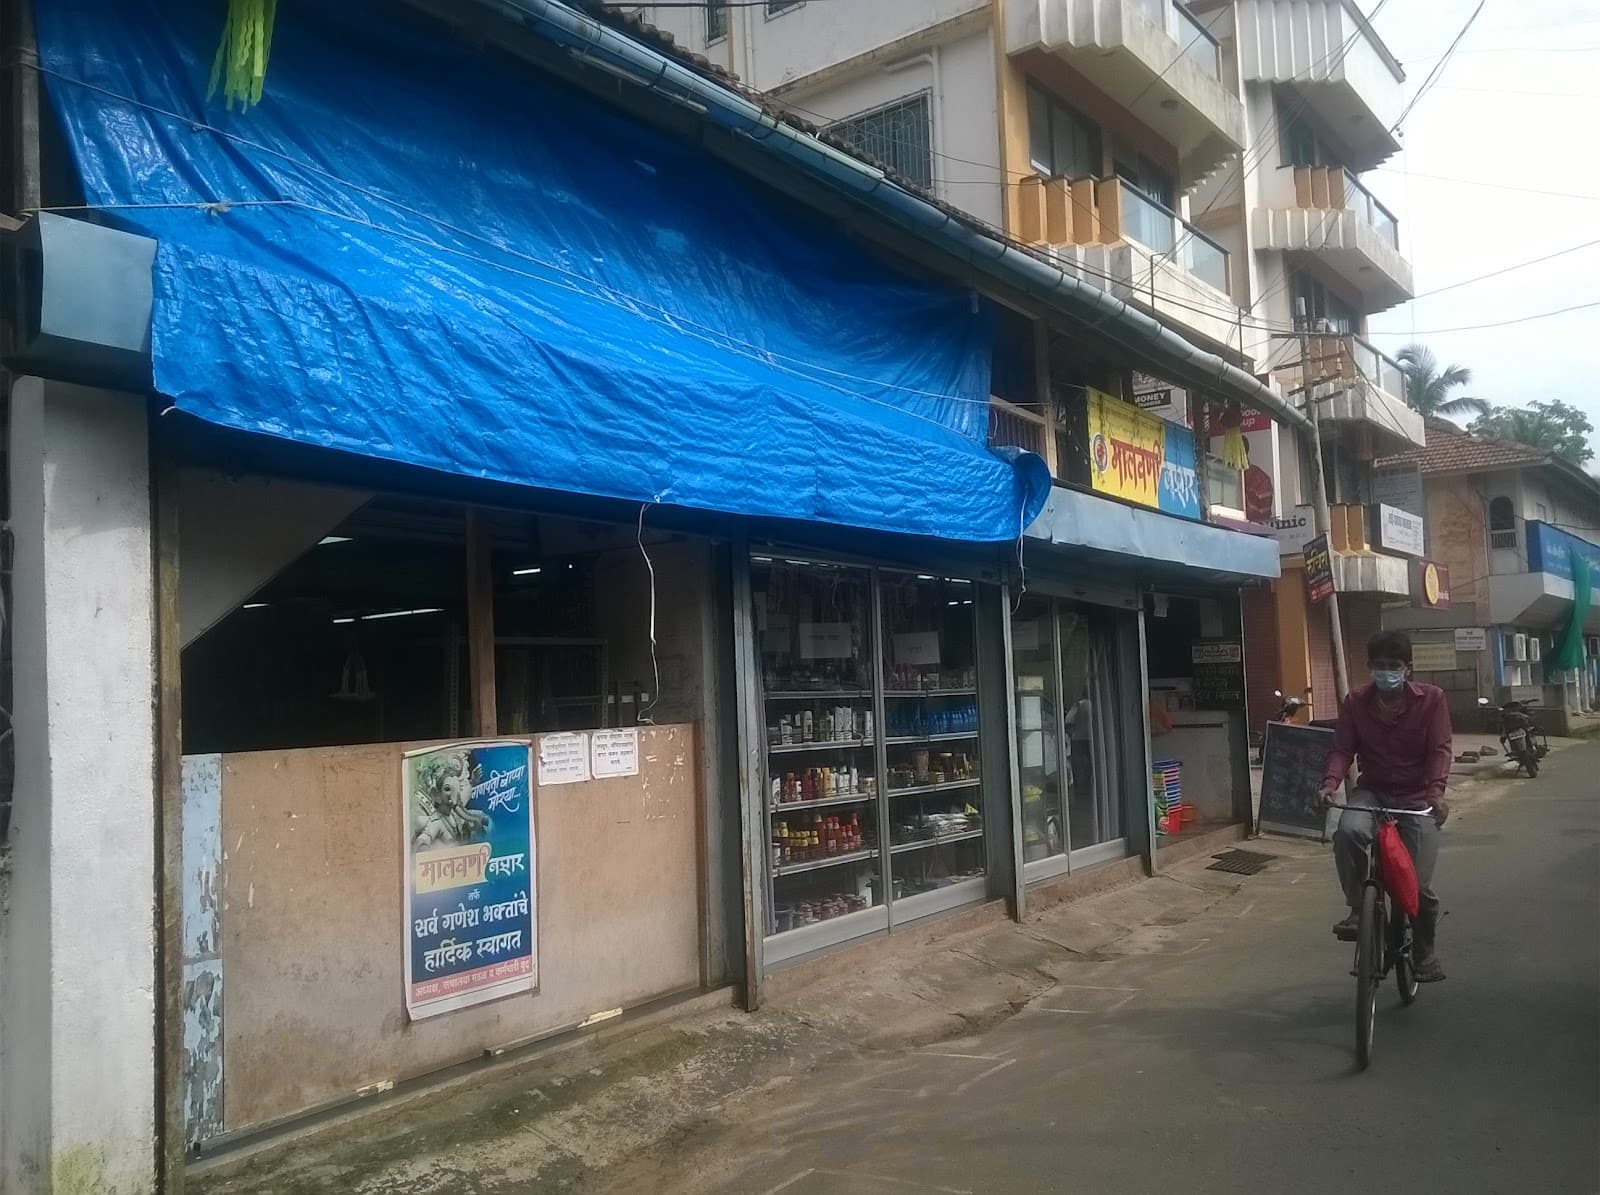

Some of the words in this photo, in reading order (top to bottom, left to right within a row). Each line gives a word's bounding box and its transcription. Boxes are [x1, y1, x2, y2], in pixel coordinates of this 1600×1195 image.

[1110, 438, 1163, 497] मालवणी
[419, 846, 488, 886] मालवणी
[415, 908, 439, 938] सर्व
[442, 902, 480, 931] गणेश
[483, 890, 529, 922] भक्तांचे
[423, 937, 473, 972] हार्दिक
[476, 930, 522, 958] स्वागत
